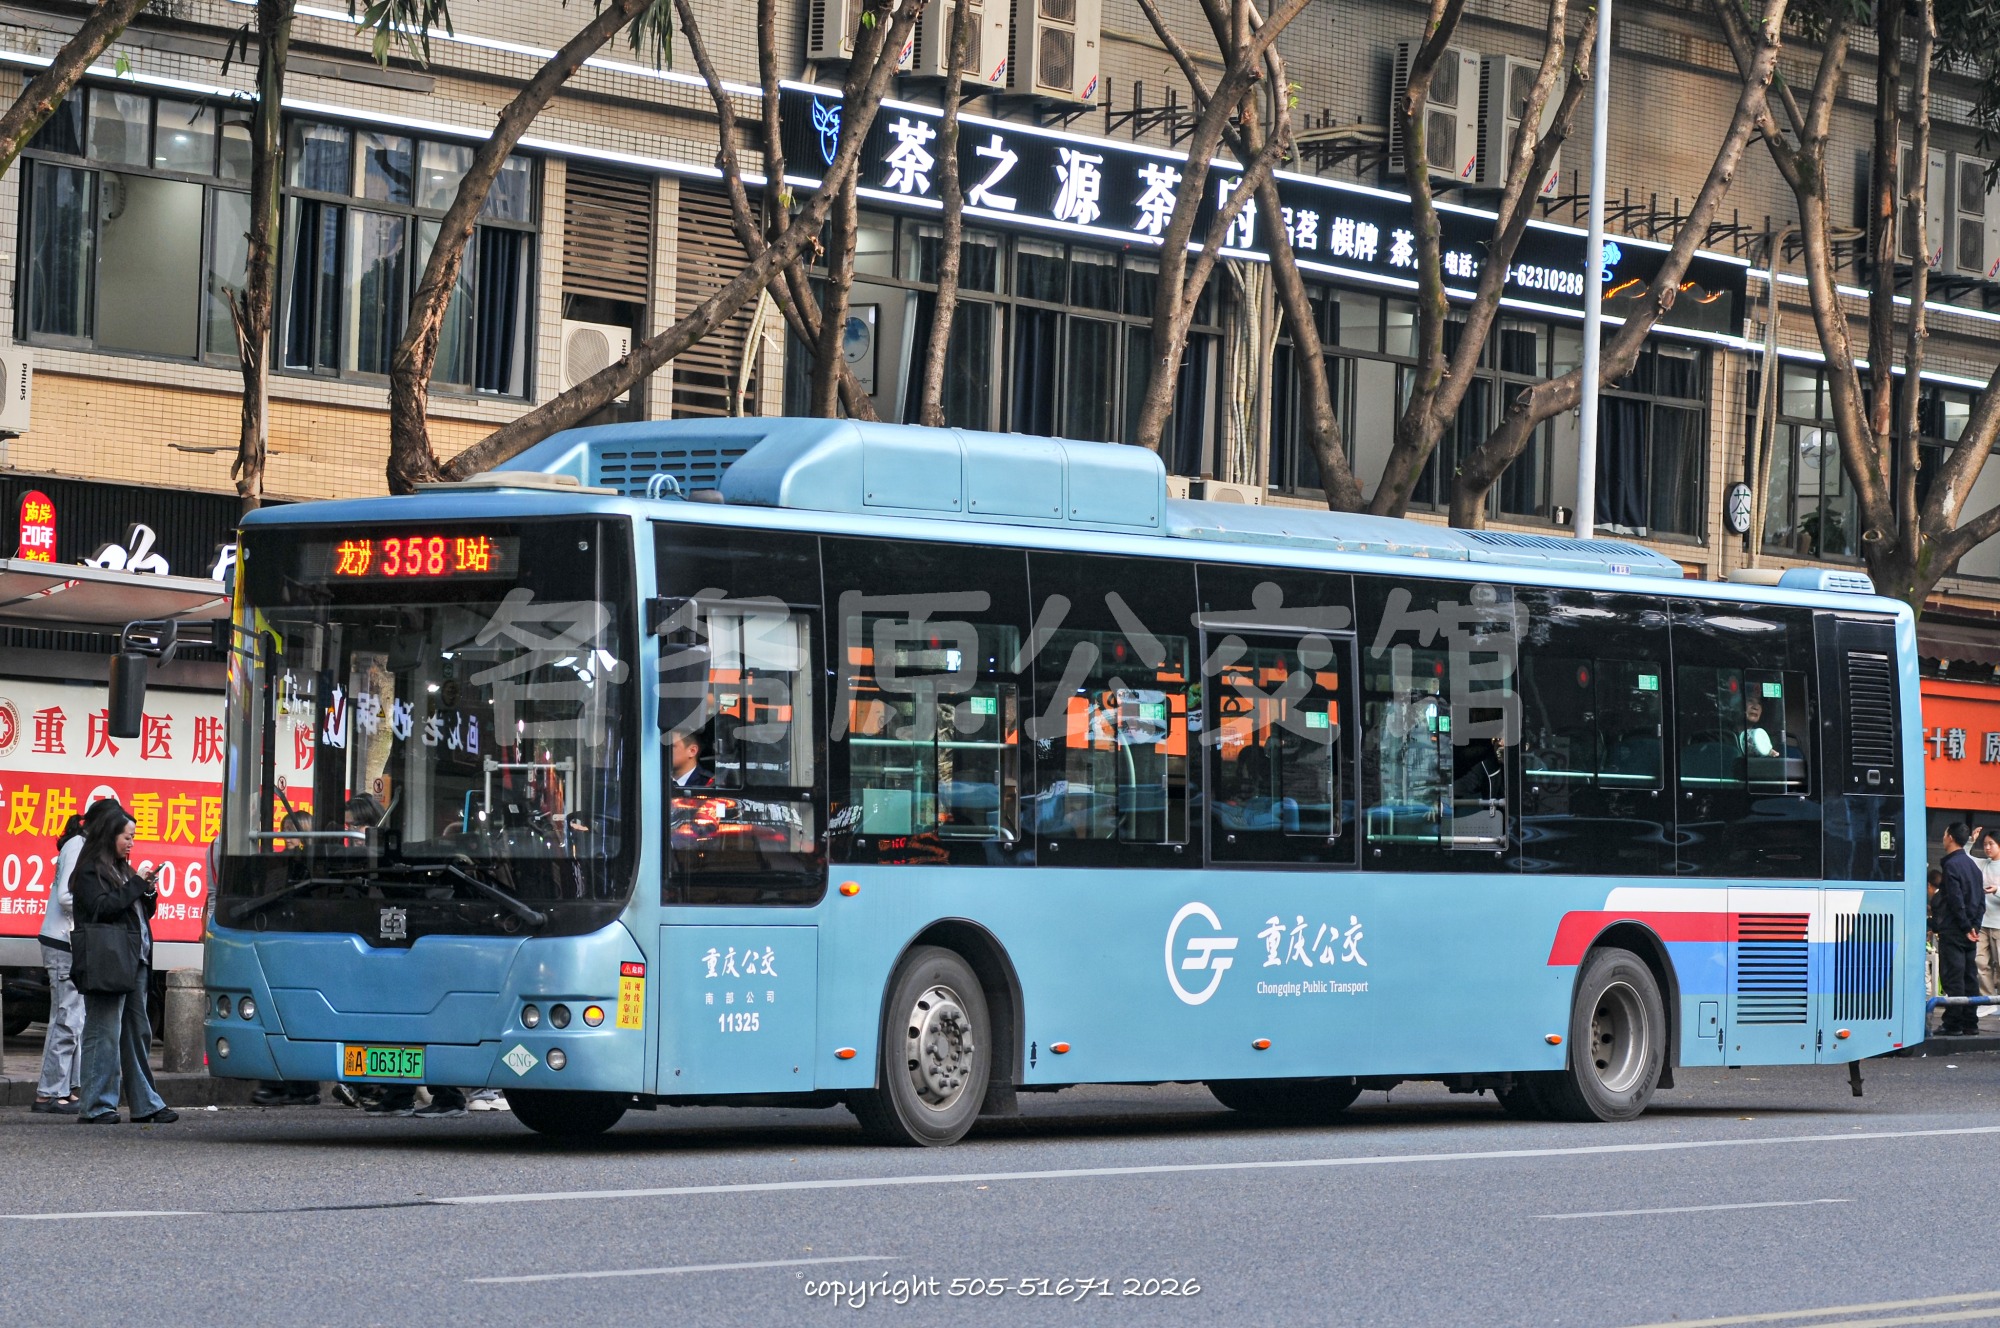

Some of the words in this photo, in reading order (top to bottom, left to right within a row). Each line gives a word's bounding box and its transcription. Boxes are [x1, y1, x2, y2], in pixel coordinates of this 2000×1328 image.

[1330, 216, 1379, 262] 棋牌
[1389, 228, 1418, 270] 茶
[20, 362, 28, 401] PHILIPS
[25, 501, 53, 524] 南岸
[1732, 488, 1750, 527] 茶
[21, 525, 54, 549] 20年
[383, 537, 445, 576] 358
[1923, 728, 1967, 759] 十载
[1257, 915, 1368, 967] 重庆公交
[702, 946, 778, 979] 重庆公交
[705, 990, 775, 1005] 南部公司
[1257, 981, 1301, 997] Chongqing
[1303, 980, 1328, 993] Public
[1329, 980, 1369, 994] Transport
[718, 1012, 760, 1033] 11325
[508, 1053, 532, 1068] CNG
